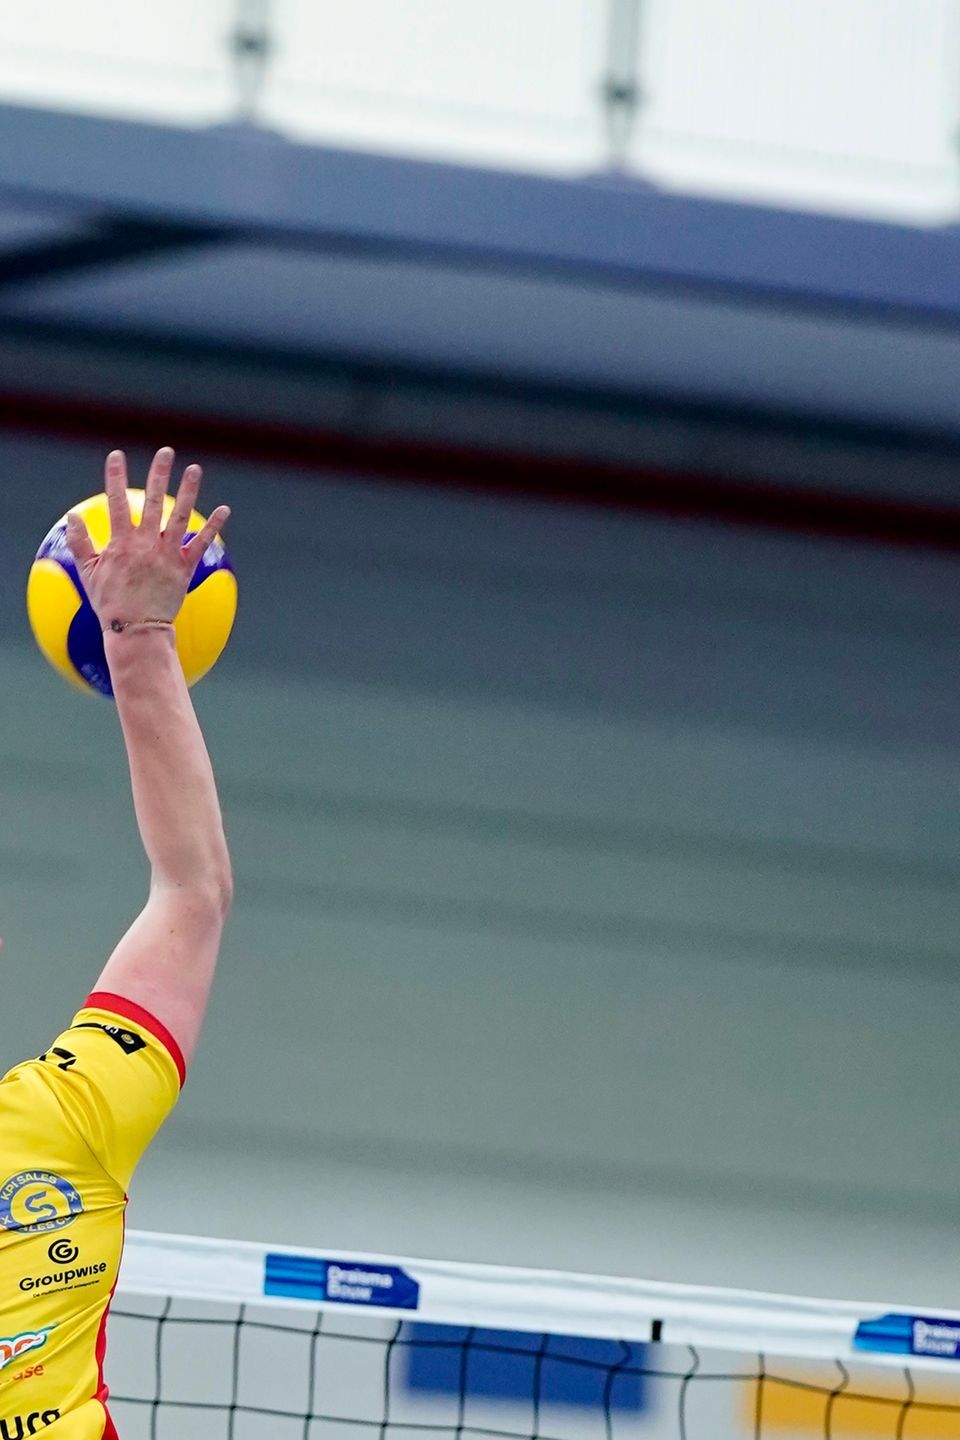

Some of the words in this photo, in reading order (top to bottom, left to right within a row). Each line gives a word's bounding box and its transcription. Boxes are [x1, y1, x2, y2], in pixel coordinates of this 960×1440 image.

[0, 1181, 19, 1201] KPI
[16, 1172, 58, 1185] SALES
[19, 1262, 107, 1291] Groupwise
